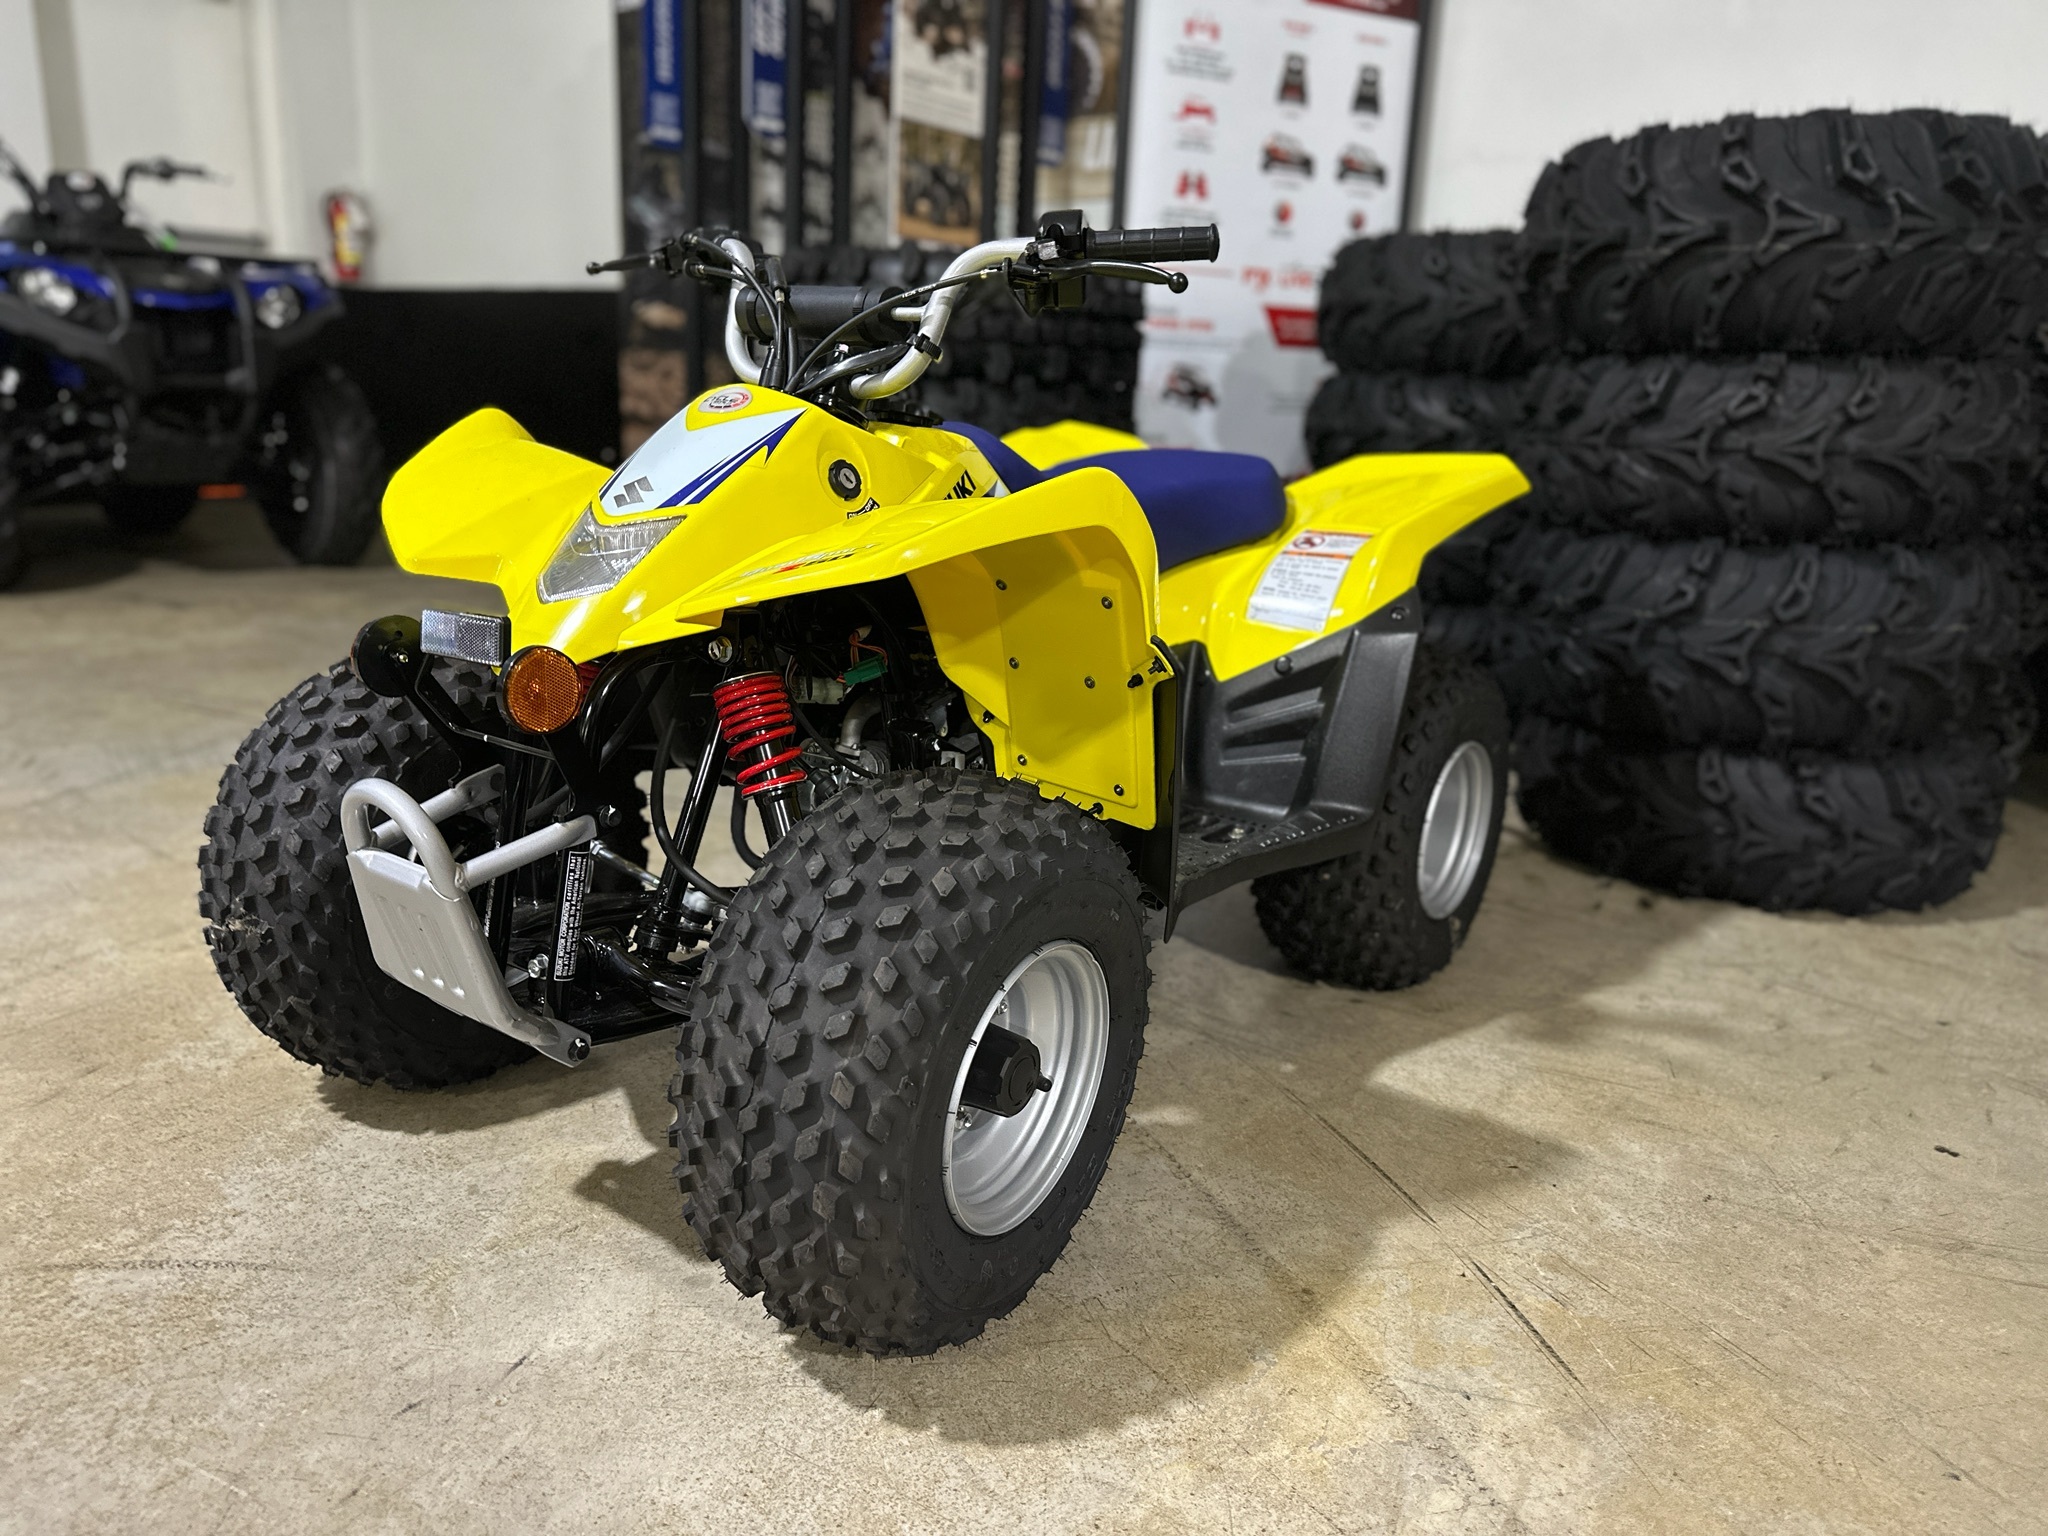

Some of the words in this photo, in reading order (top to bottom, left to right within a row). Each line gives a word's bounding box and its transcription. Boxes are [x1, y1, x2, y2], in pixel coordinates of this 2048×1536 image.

[574, 857, 582, 879] National
[571, 881, 579, 904] American
[556, 959, 564, 976] SUZUKI
[561, 901, 571, 937] CORPORATION
[566, 872, 574, 900] certifies
